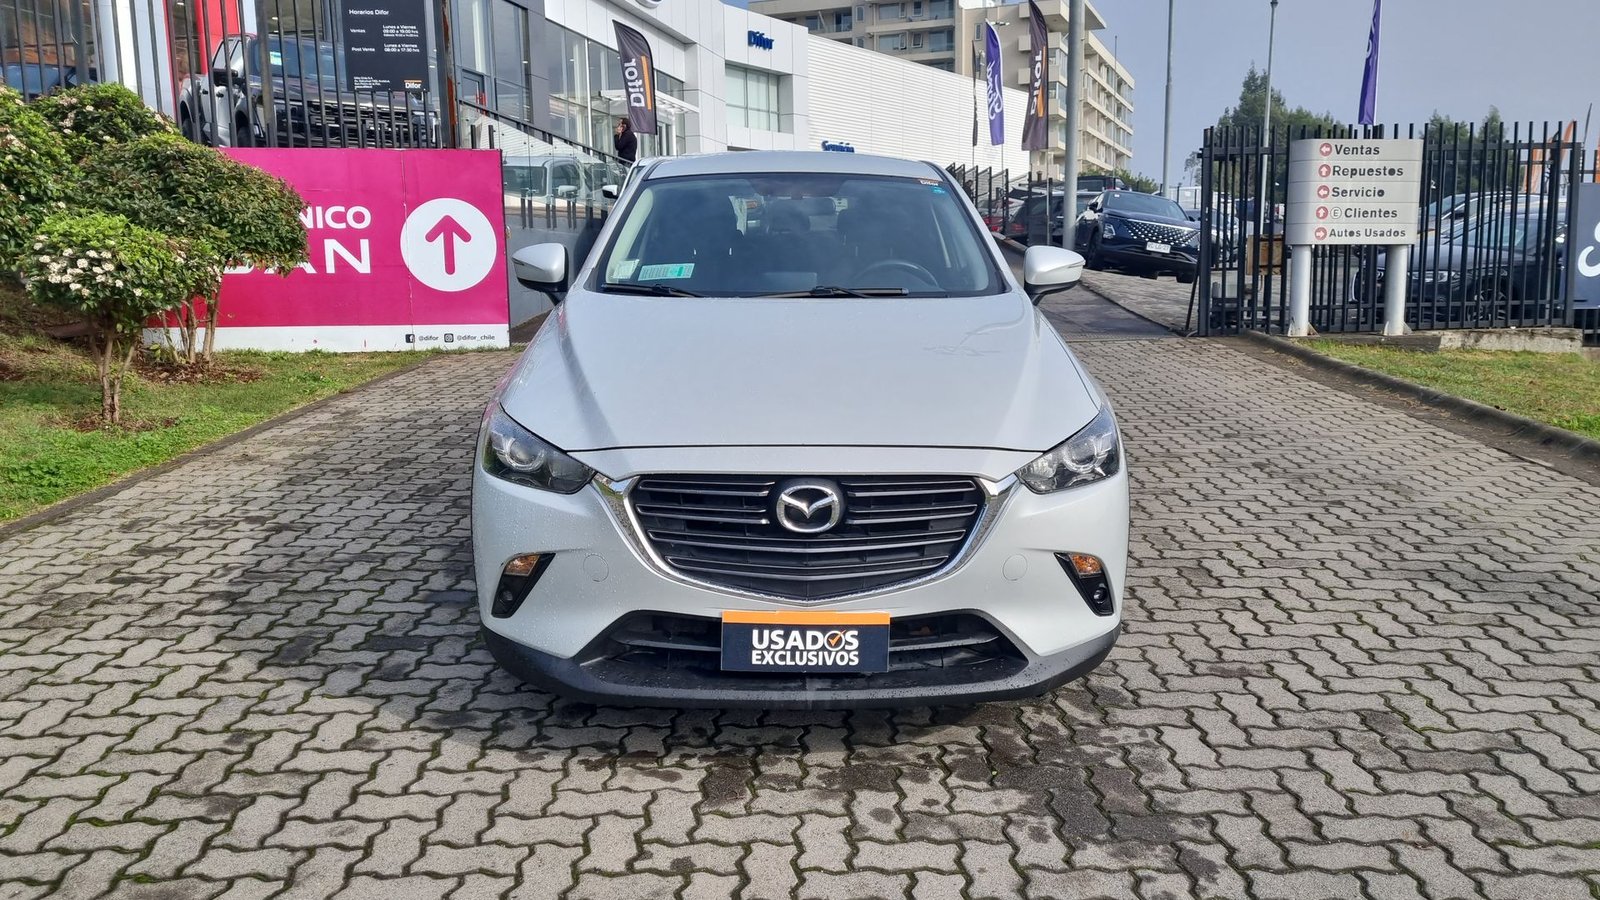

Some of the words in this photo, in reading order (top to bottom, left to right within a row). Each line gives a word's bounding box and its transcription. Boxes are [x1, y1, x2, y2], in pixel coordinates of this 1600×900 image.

[747, 30, 775, 51] Difor
[1334, 144, 1380, 155] Ventas
[1332, 165, 1404, 178] Repuestos
[1331, 187, 1385, 197] Servicio
[1344, 208, 1398, 218] Clientes
[1328, 228, 1361, 238] Autos
[1364, 228, 1406, 237] Usados
[456, 334, 495, 342] @difor_chile
[752, 629, 859, 651] USADOS
[751, 650, 859, 666] EXCLUSIVOS
